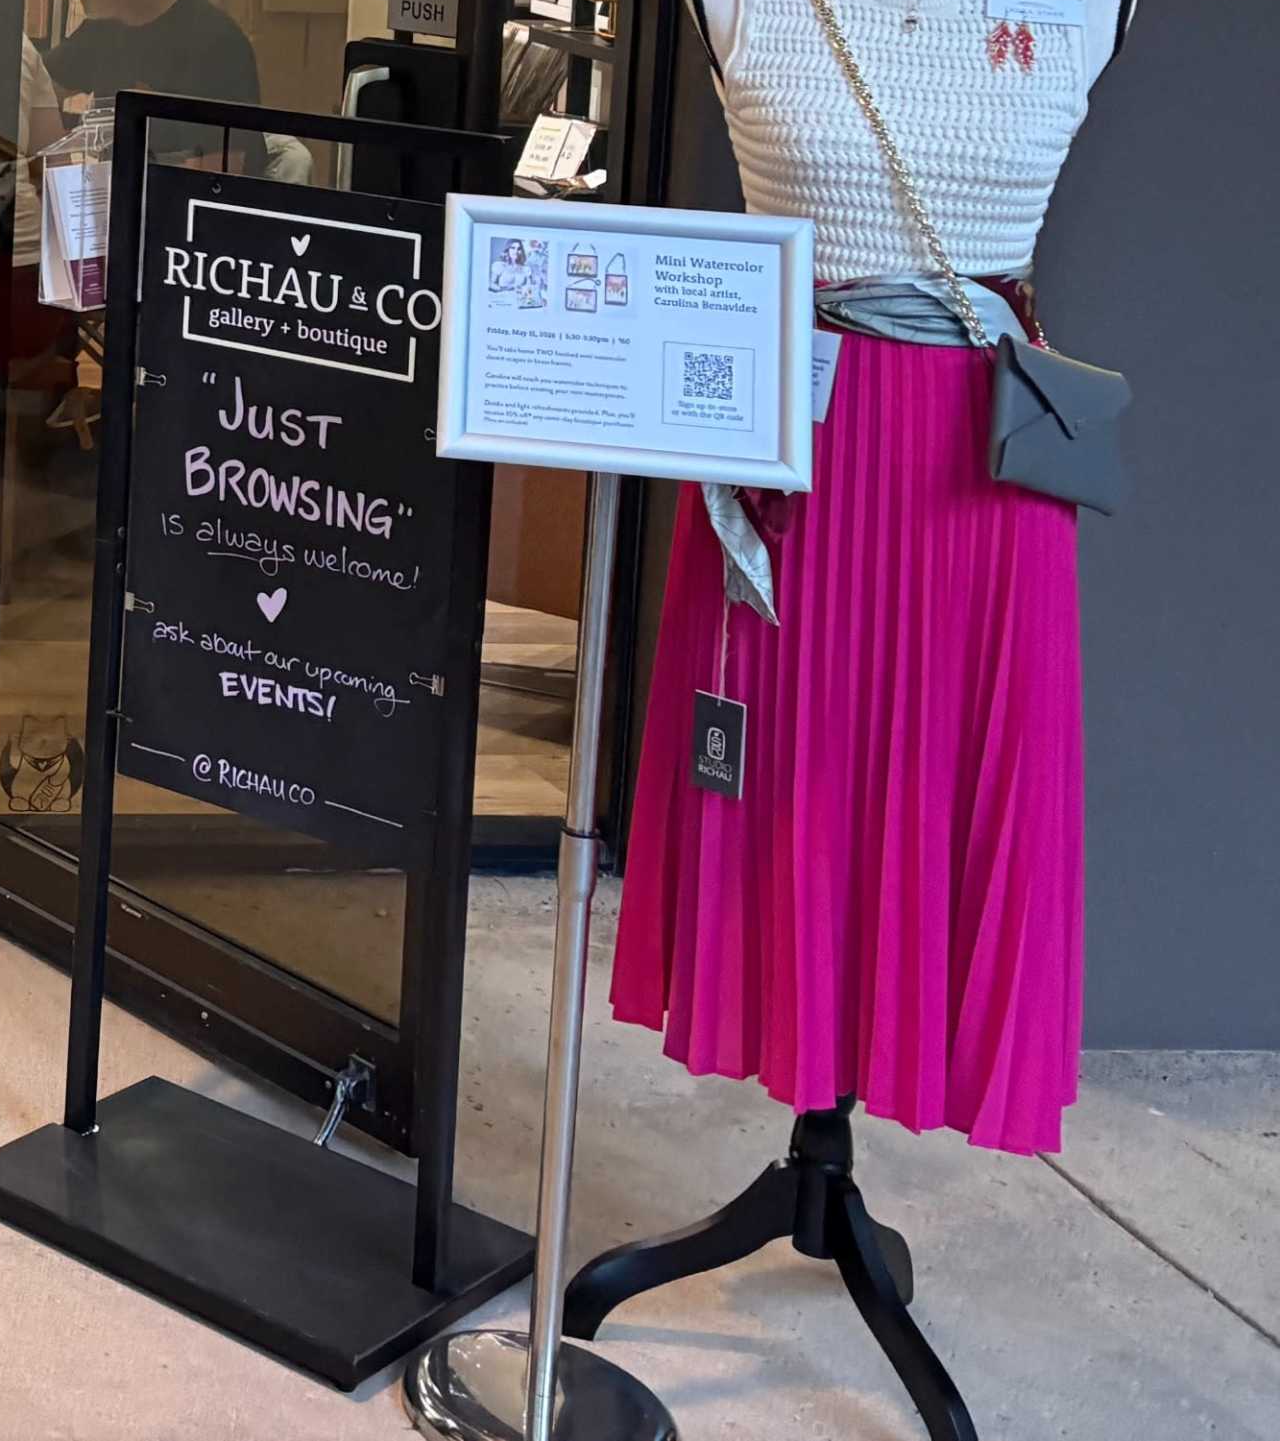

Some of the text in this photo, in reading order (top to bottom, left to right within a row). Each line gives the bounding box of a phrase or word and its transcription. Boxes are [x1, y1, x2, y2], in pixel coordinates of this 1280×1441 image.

[400, 0, 445, 23] PUSH
[655, 254, 764, 274] Mini Watercolor
[655, 270, 723, 288] Workshop
[163, 246, 442, 331] RICHAU & CO
[654, 285, 742, 300] with local artist,
[208, 307, 388, 355] gallery + boutique
[196, 518, 296, 576] always
[304, 546, 420, 590] welcome!
[152, 621, 410, 717] ask about our upcoming
[219, 671, 337, 722] EVENTS!
